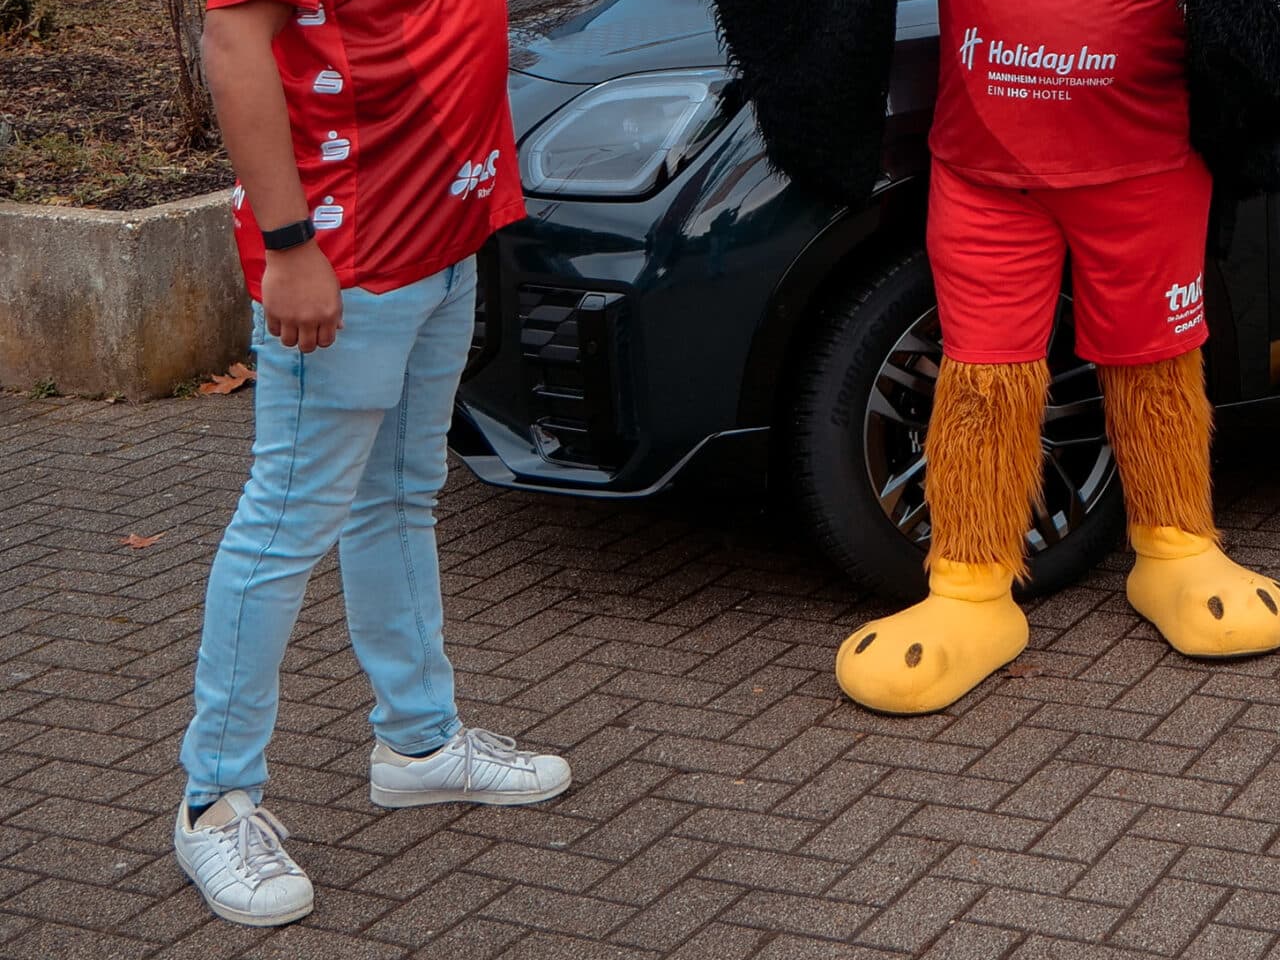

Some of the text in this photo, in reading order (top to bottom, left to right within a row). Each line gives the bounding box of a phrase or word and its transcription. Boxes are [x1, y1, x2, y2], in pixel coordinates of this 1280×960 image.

[988, 40, 1117, 75] Holiday Inn
[988, 71, 1115, 87] MANNHEIM HAUPTBAHNHOF
[987, 85, 1005, 97] EIN
[1032, 89, 1072, 101] HOTEL
